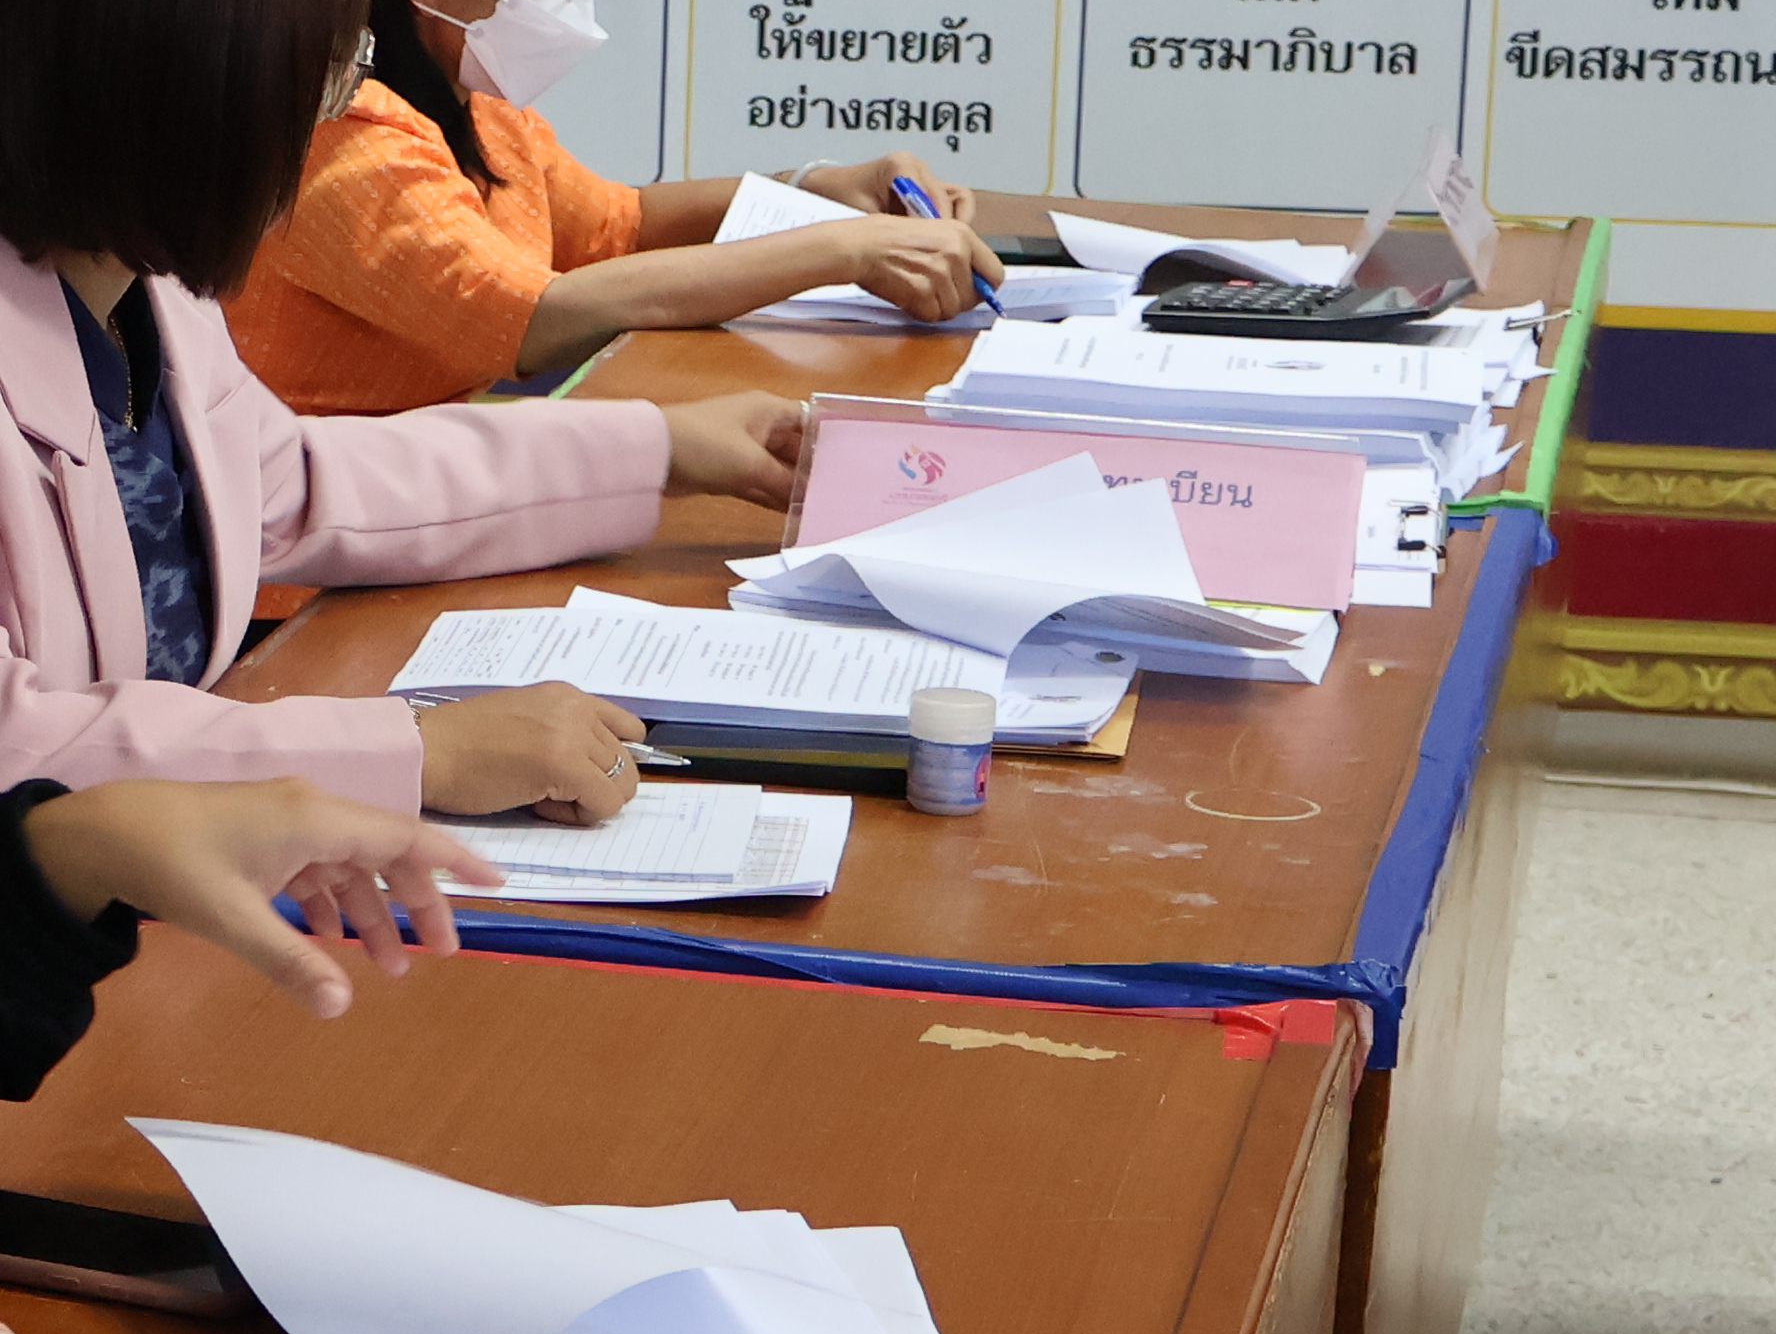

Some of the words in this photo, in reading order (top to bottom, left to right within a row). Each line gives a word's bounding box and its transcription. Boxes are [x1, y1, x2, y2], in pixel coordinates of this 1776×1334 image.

[751, 5, 994, 66] ให้ขยายตัว
[1129, 28, 1419, 76] ธรรมาภิบาล
[747, 85, 994, 151] อย่างสมดุล
